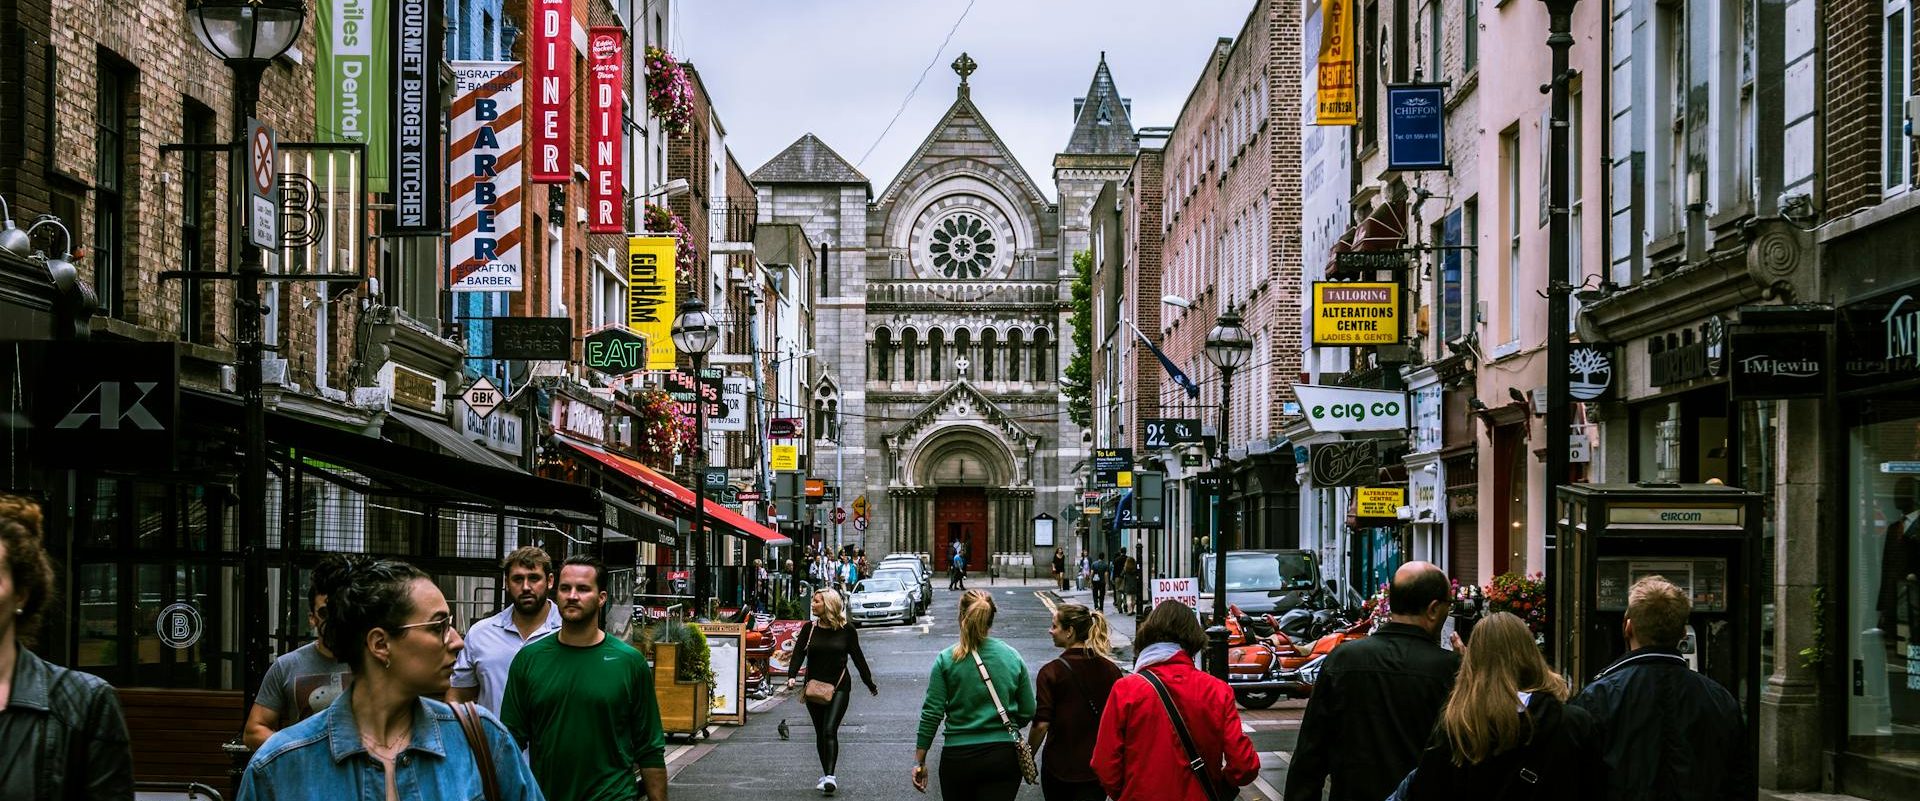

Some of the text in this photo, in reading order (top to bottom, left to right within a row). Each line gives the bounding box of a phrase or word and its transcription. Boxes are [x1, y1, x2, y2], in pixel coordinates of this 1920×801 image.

[467, 70, 518, 80] GRAFTON
[1321, 65, 1351, 86] CENTRE
[468, 83, 512, 92] BARBER
[542, 9, 560, 173] DINER
[342, 61, 363, 142] Dental
[403, 80, 420, 147] BURGER
[1394, 106, 1437, 115] CHIFFON
[598, 84, 613, 224] DINER
[473, 97, 500, 261] BARBER
[403, 152, 420, 226] KITCHEN
[467, 264, 517, 272] GRAFTON
[467, 276, 512, 285] BARBER
[631, 254, 669, 322] GOTHAM
[1327, 290, 1387, 301] TAILORING
[1322, 307, 1393, 318] ALTERATIONS
[1337, 320, 1378, 331] CENTRE
[1364, 333, 1393, 341] GENTS
[588, 338, 642, 368] EAT
[472, 391, 494, 403] GBK
[1312, 401, 1400, 422] e cig co
[829, 512, 846, 520] SOP
[1159, 580, 1189, 592] DO NOT
[172, 613, 190, 639] B
